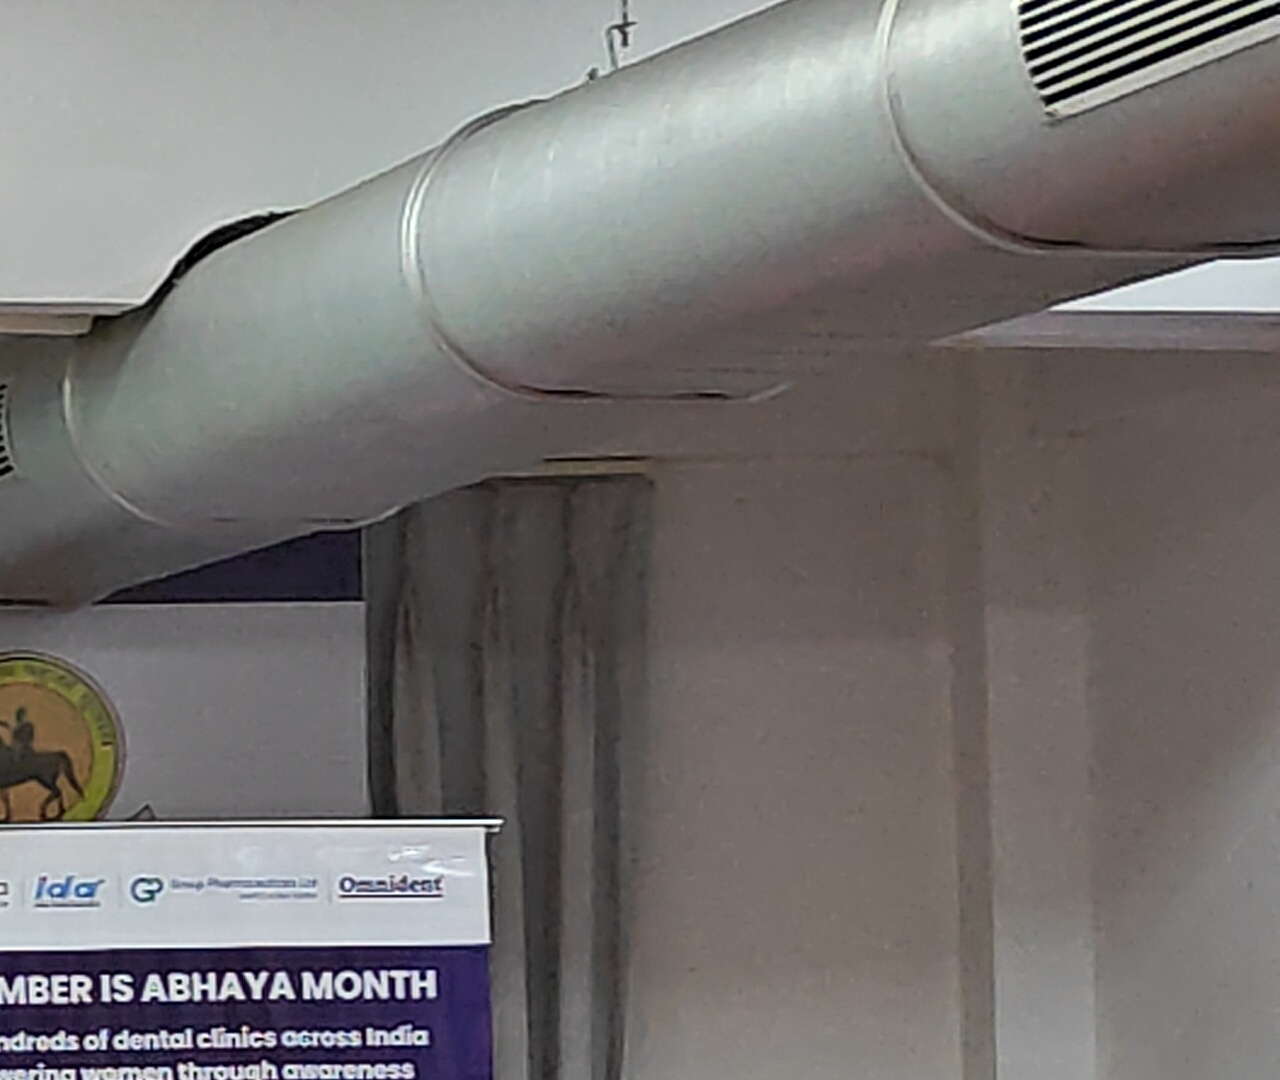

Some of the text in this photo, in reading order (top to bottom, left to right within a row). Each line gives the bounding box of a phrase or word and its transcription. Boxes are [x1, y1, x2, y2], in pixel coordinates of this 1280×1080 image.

[340, 875, 444, 894] Omnident
[99, 973, 135, 1003] IS
[141, 971, 297, 1003] ABHAYA
[300, 969, 438, 1000] MONTH
[82, 1028, 110, 1051] of
[111, 1028, 192, 1051] dental
[196, 1025, 278, 1049] clinics
[281, 1030, 362, 1047] across
[365, 1024, 431, 1047] India
[280, 1061, 417, 1080] awareness
